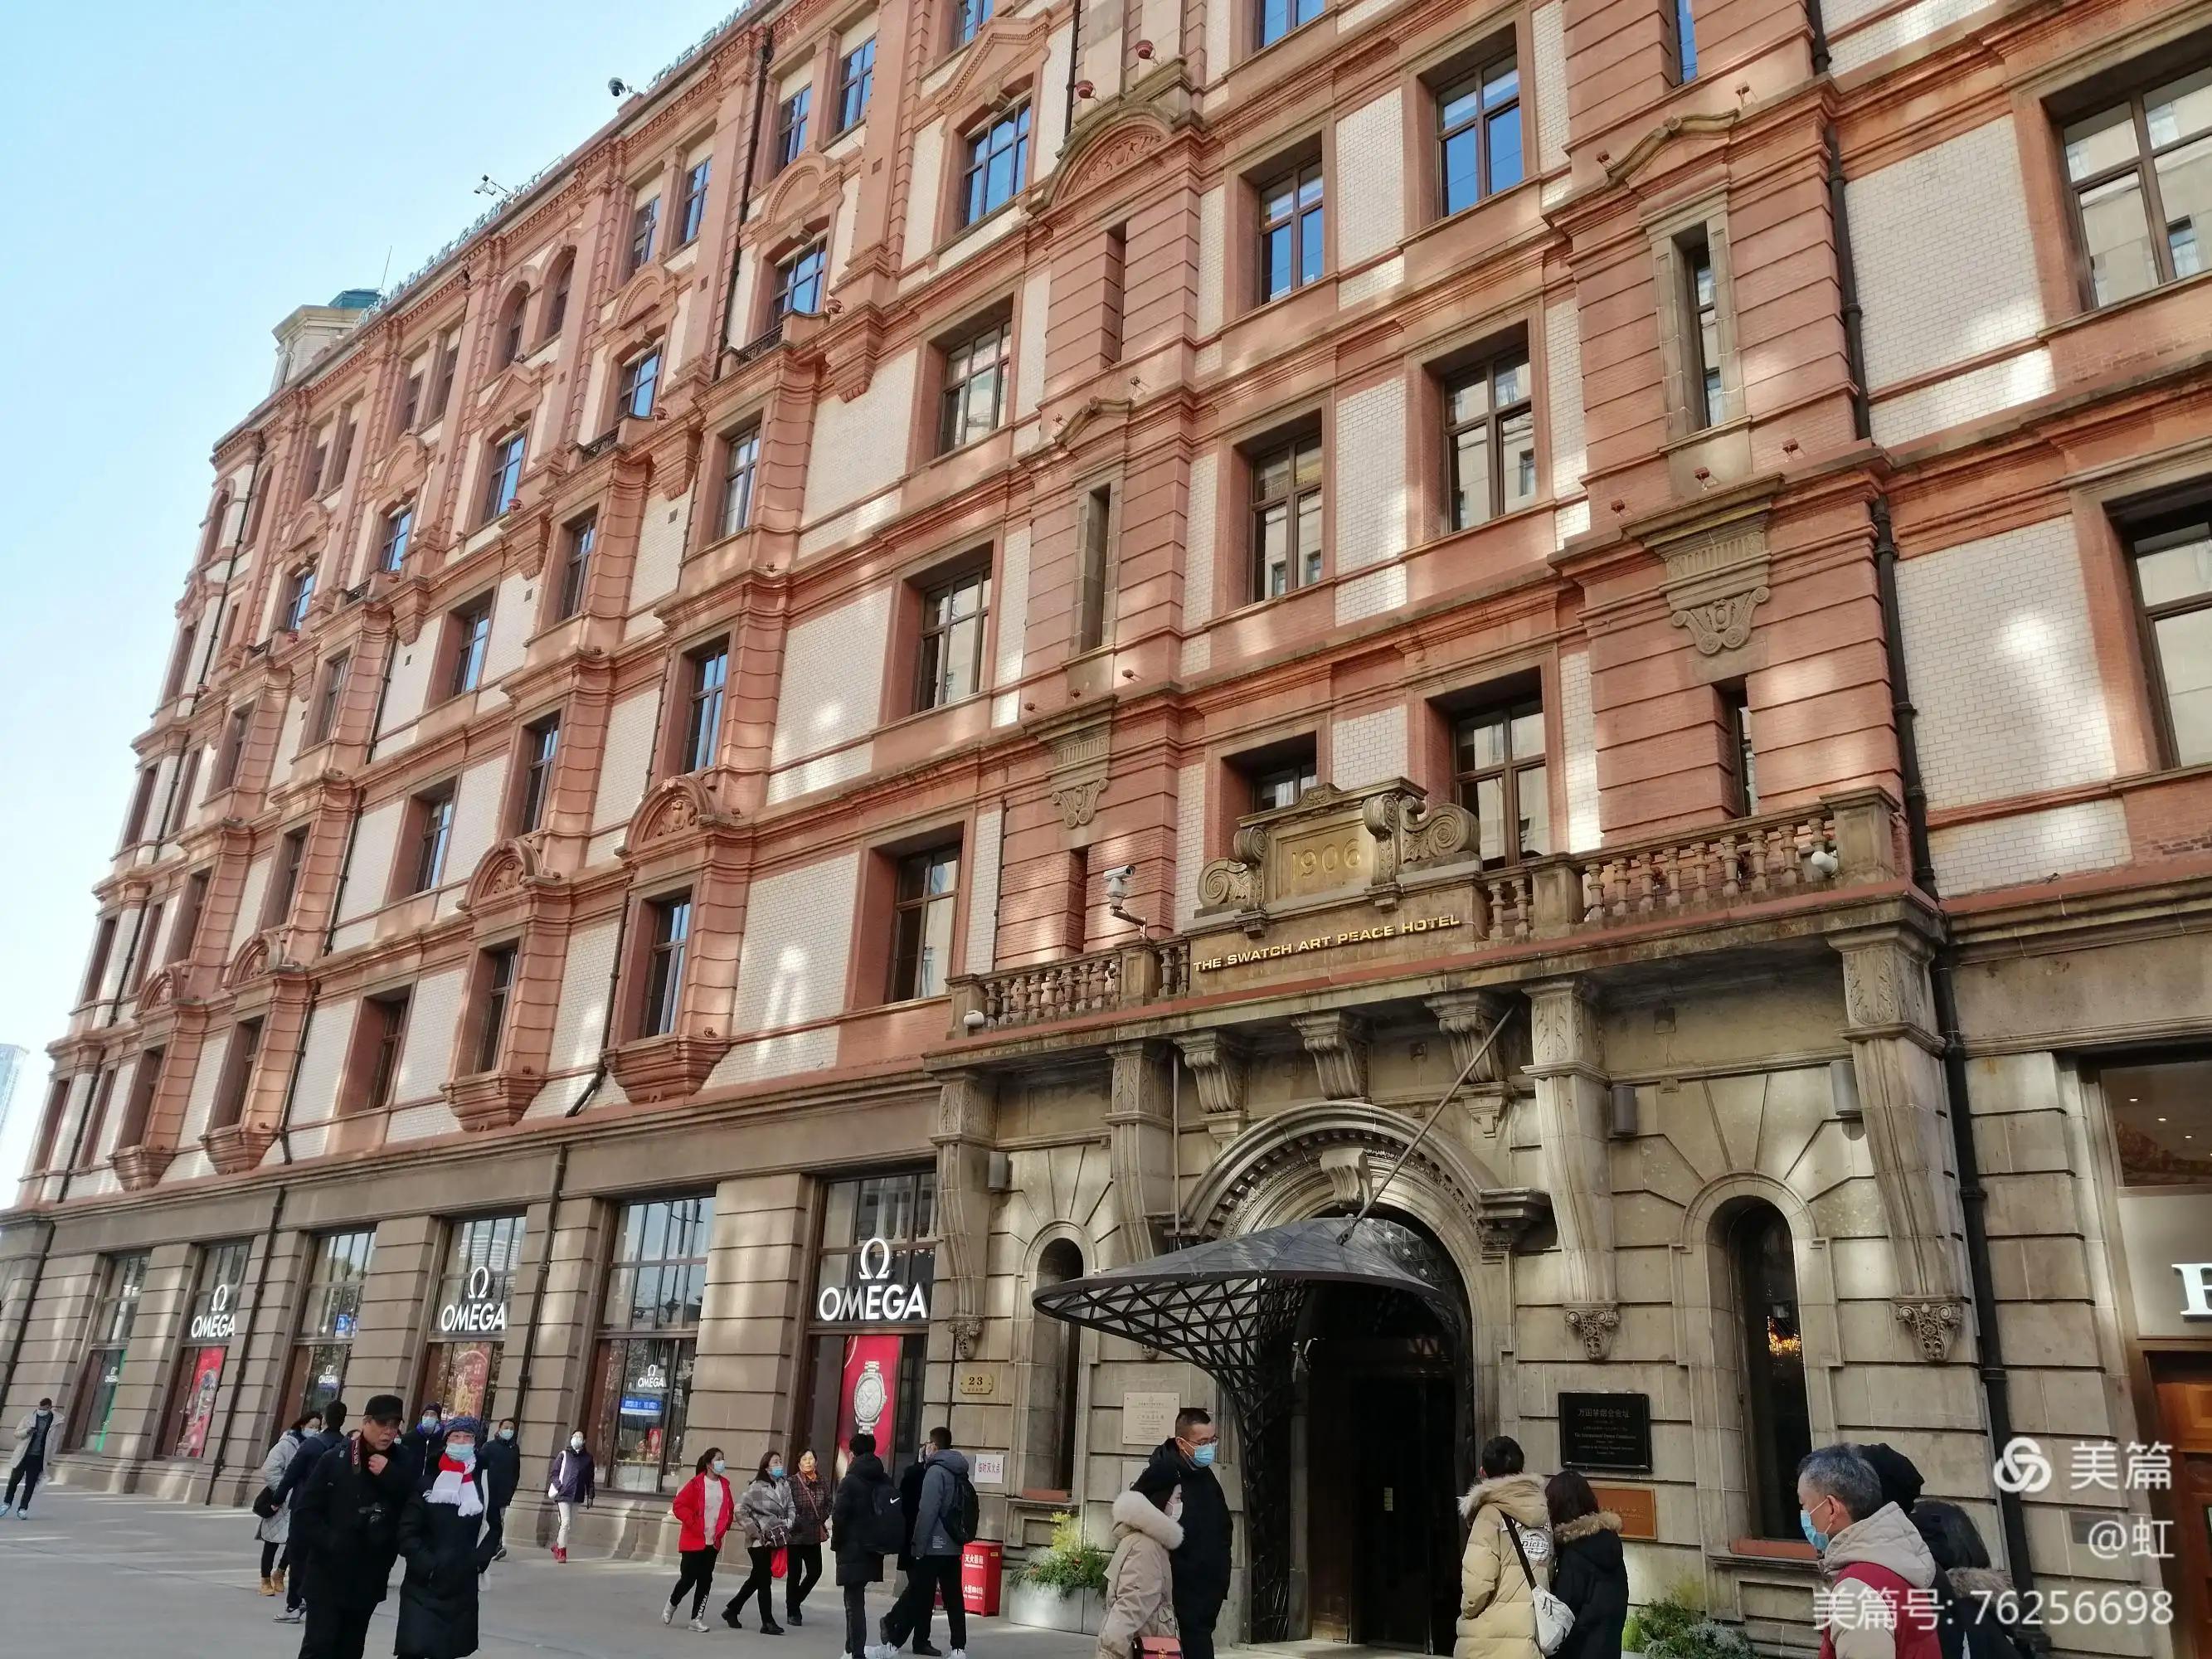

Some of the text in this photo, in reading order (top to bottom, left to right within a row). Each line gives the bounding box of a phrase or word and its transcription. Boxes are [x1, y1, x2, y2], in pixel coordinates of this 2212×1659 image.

[1291, 837, 1361, 881] 1906
[1193, 915, 1461, 971] THE SWATCH ART PEACE HOTEL
[440, 1301, 506, 1331] OMEGA
[819, 1282, 928, 1321] OMEGA
[191, 1313, 236, 1338] OMEGA
[637, 1377, 664, 1388] OMEGA
[968, 1376, 983, 1386] 23
